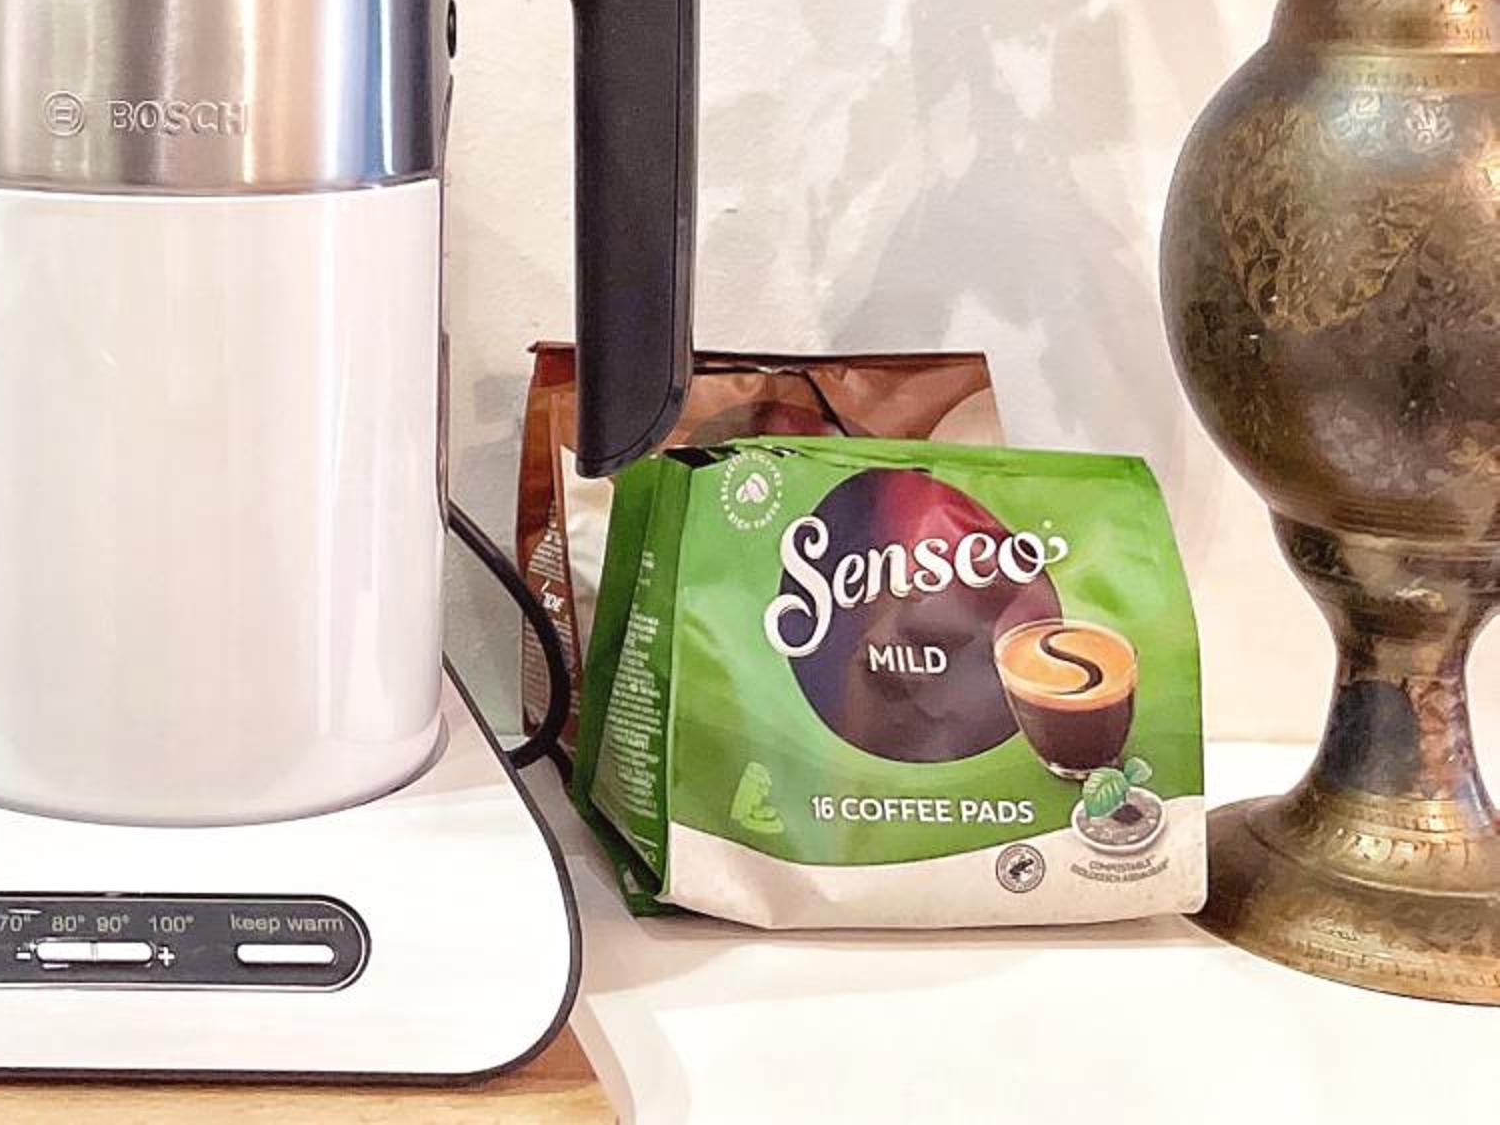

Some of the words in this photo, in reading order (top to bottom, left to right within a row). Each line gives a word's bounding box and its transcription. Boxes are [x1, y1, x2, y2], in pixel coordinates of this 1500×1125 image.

[107, 100, 247, 136] BOSCH
[764, 516, 1068, 658] Senseo
[868, 644, 947, 674] MILD
[811, 796, 835, 820] 16
[840, 797, 953, 823] COFFEE
[959, 800, 1035, 824] PADS
[230, 913, 281, 934] keep
[287, 916, 345, 932] warm
